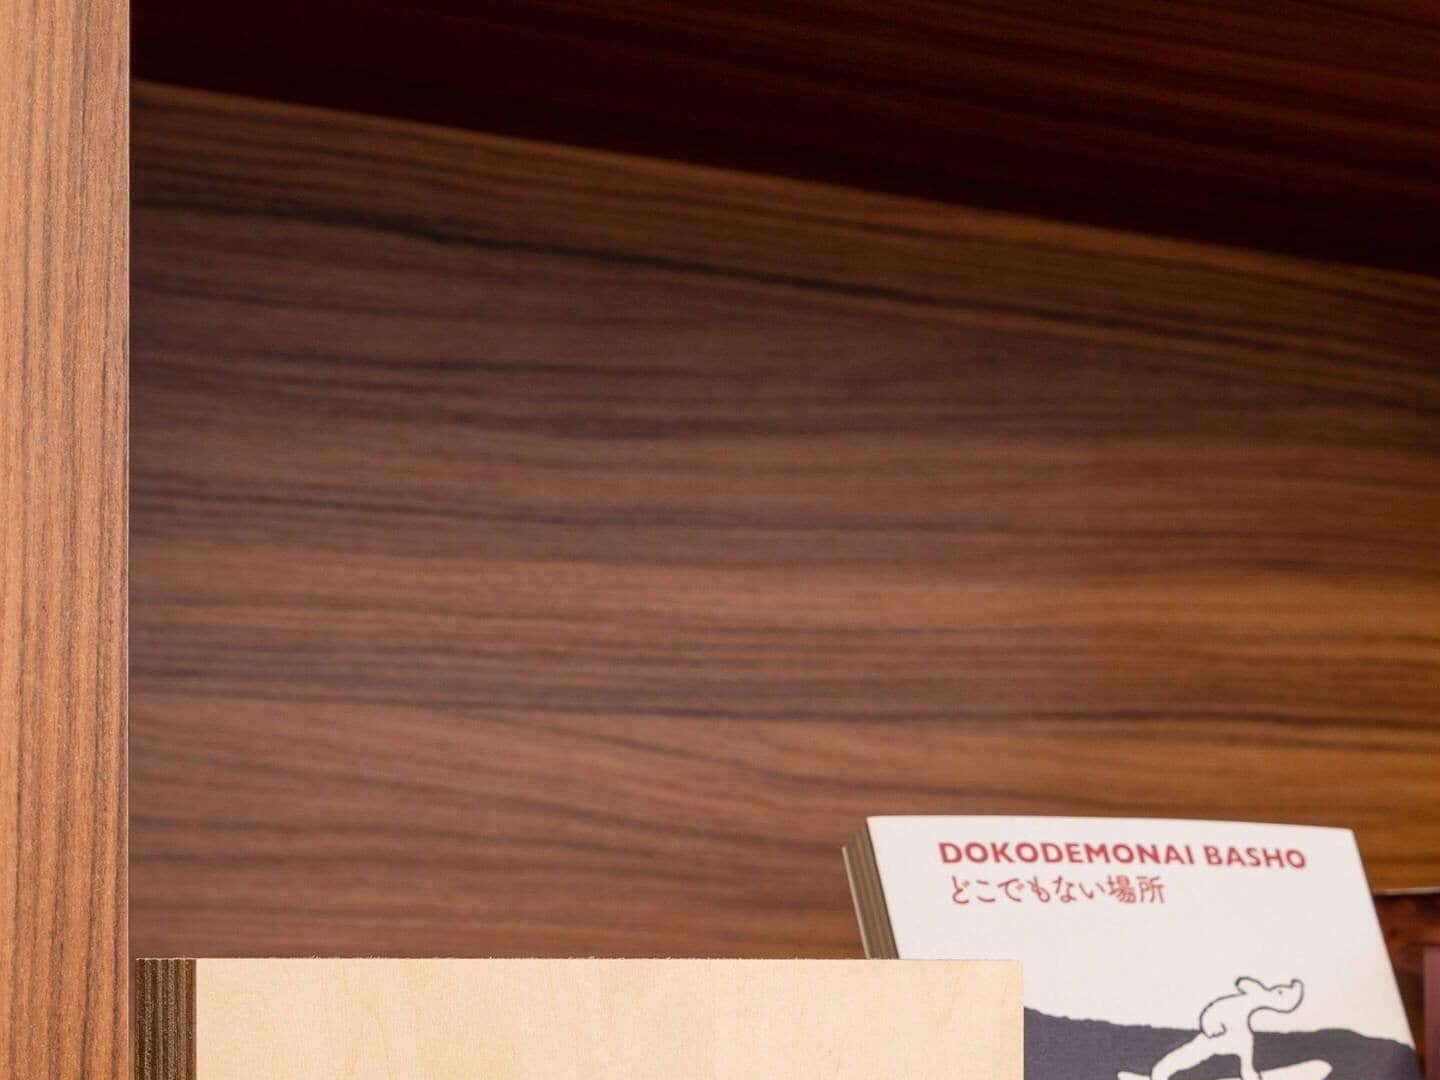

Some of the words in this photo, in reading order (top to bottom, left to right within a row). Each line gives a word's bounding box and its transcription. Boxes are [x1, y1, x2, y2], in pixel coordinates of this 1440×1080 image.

[938, 841, 1196, 866] DOKODEMONAI
[1203, 844, 1308, 869] BASHO
[951, 874, 1167, 905] どこでもない場所
